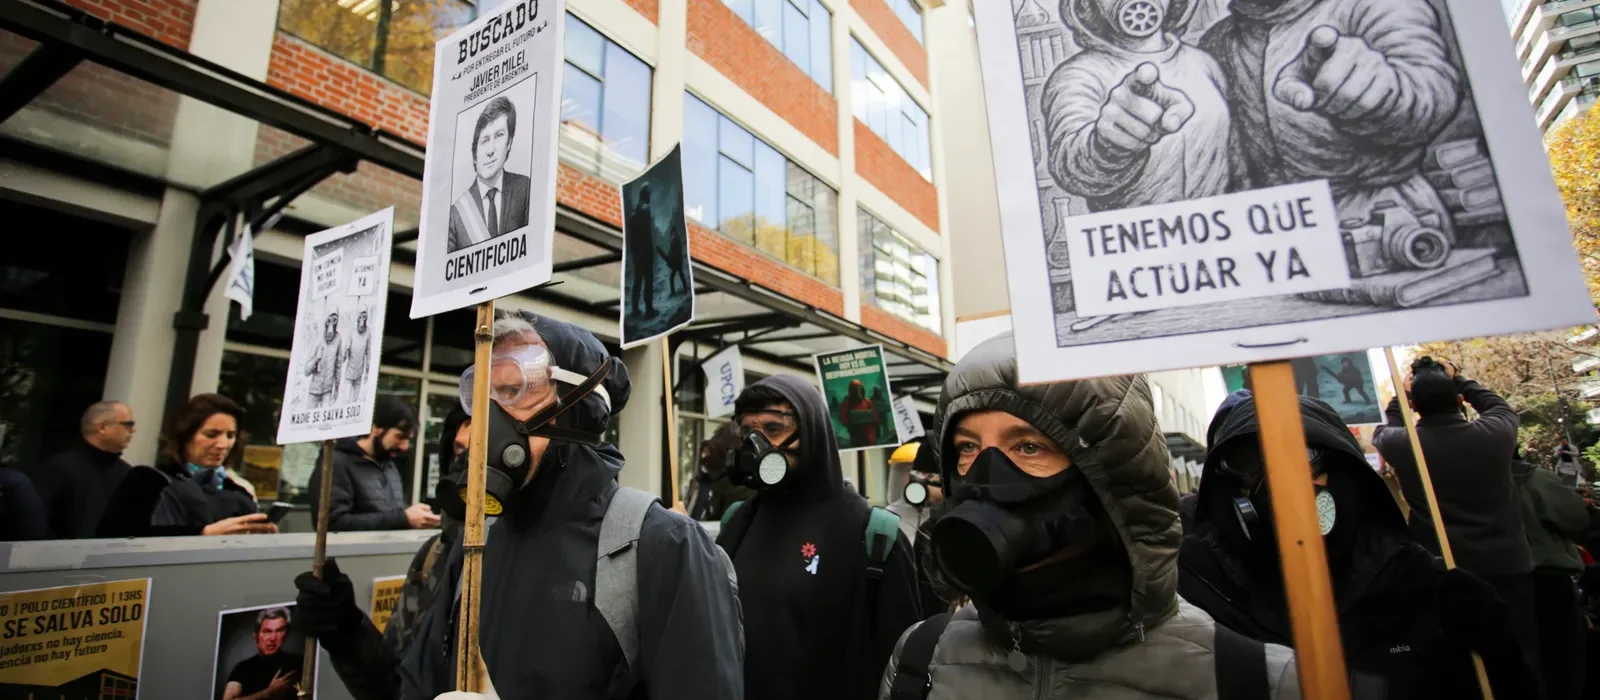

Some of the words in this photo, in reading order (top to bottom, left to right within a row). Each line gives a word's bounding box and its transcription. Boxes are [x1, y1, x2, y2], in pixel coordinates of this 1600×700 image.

[458, 0, 538, 64] BUSCADO
[463, 64, 475, 76] POR
[475, 47, 504, 70] ENTREGAR
[504, 43, 512, 53] EL
[513, 28, 536, 48] FUTURO
[464, 83, 492, 103] PRESIDENTE
[494, 80, 500, 89] DE
[501, 62, 528, 84] ARGENTINA
[470, 65, 500, 92] JAVIER
[502, 50, 525, 73] MILEI
[1081, 210, 1232, 258] TENEMOS
[1248, 197, 1318, 235] QUE
[445, 234, 527, 282] CIENTIFICIDA
[1106, 257, 1240, 302] ACTUAR
[1256, 247, 1310, 283] YA
[823, 356, 831, 365] LA
[720, 362, 734, 406] UPCN
[291, 412, 310, 424] NADIE
[312, 411, 320, 423] SE
[323, 408, 343, 422] SALVA
[346, 405, 361, 418] SOLO
[3, 618, 28, 639] SE
[34, 610, 93, 634] SALVA
[99, 604, 141, 626] SOLO
[20, 601, 48, 614] POLO
[119, 590, 142, 602] 13HS
[34, 653, 48, 663] no
[51, 649, 71, 660] hay
[74, 644, 107, 657] futuro
[46, 638, 60, 648] no
[63, 636, 82, 650] hay
